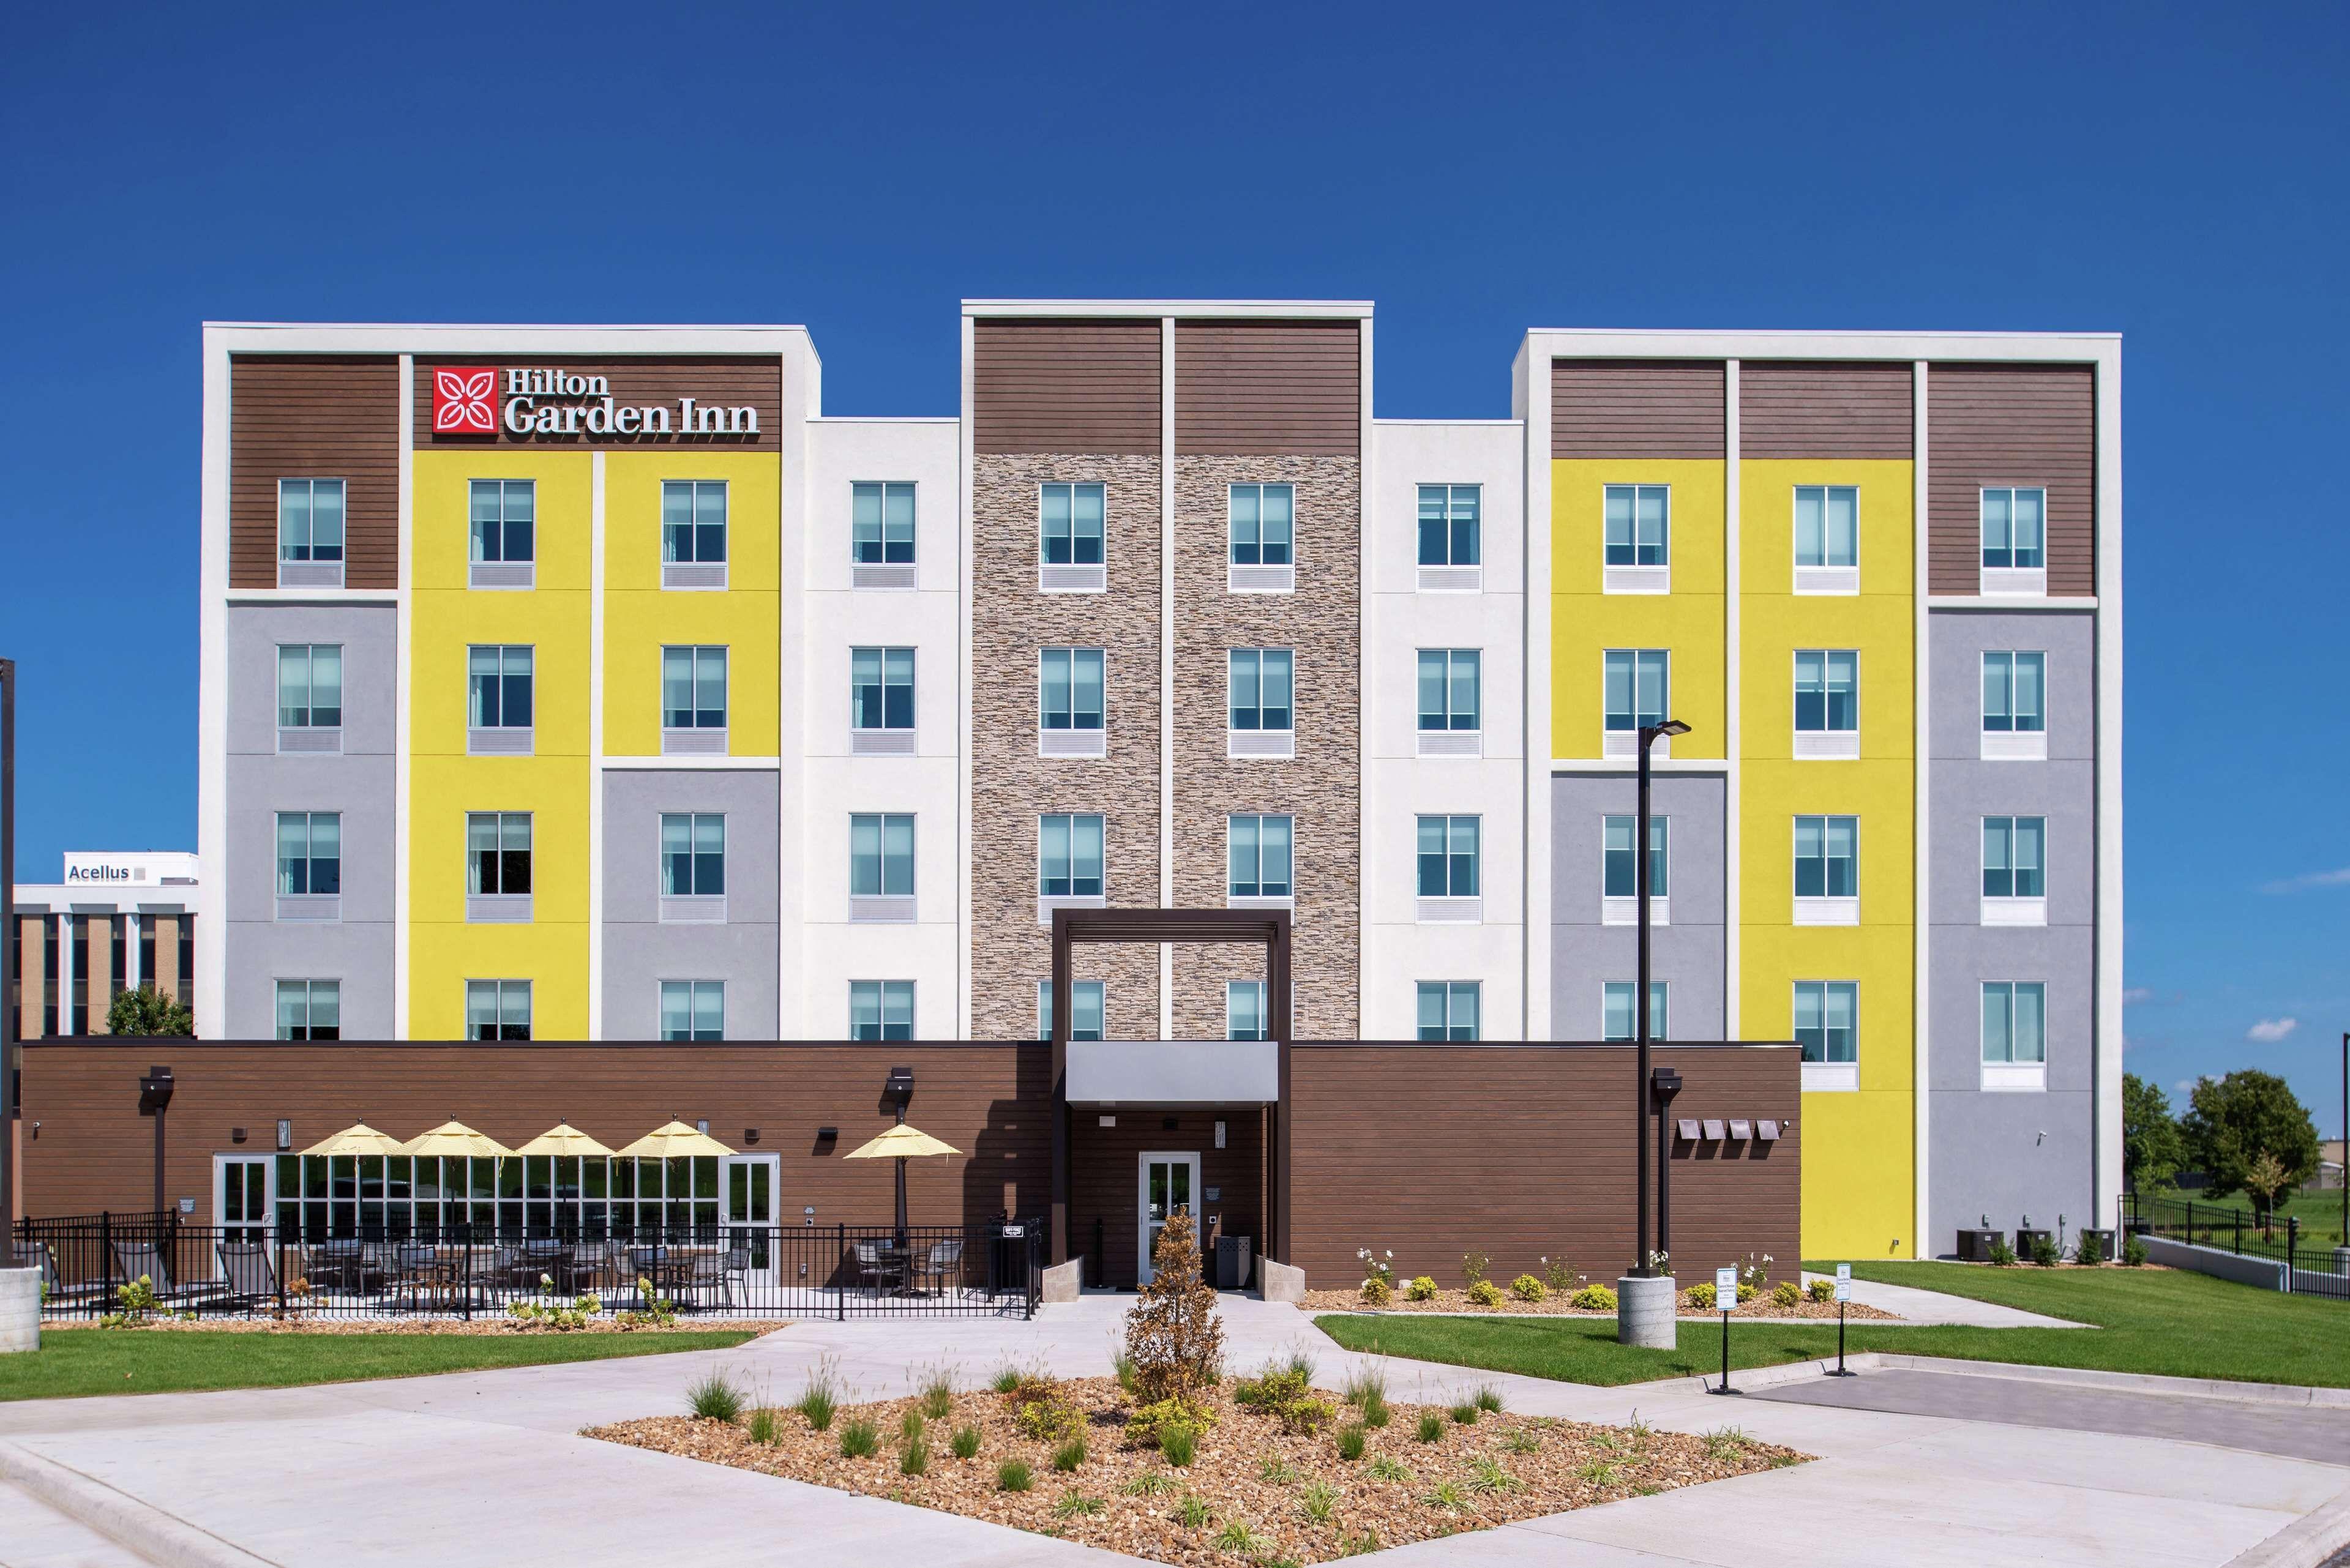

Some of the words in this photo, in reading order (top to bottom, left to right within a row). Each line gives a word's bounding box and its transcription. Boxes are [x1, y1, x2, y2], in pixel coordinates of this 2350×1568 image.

[506, 369, 610, 396] Hilton
[504, 397, 672, 435] Garden
[678, 398, 760, 435] Inn
[69, 865, 129, 879] Acellus
